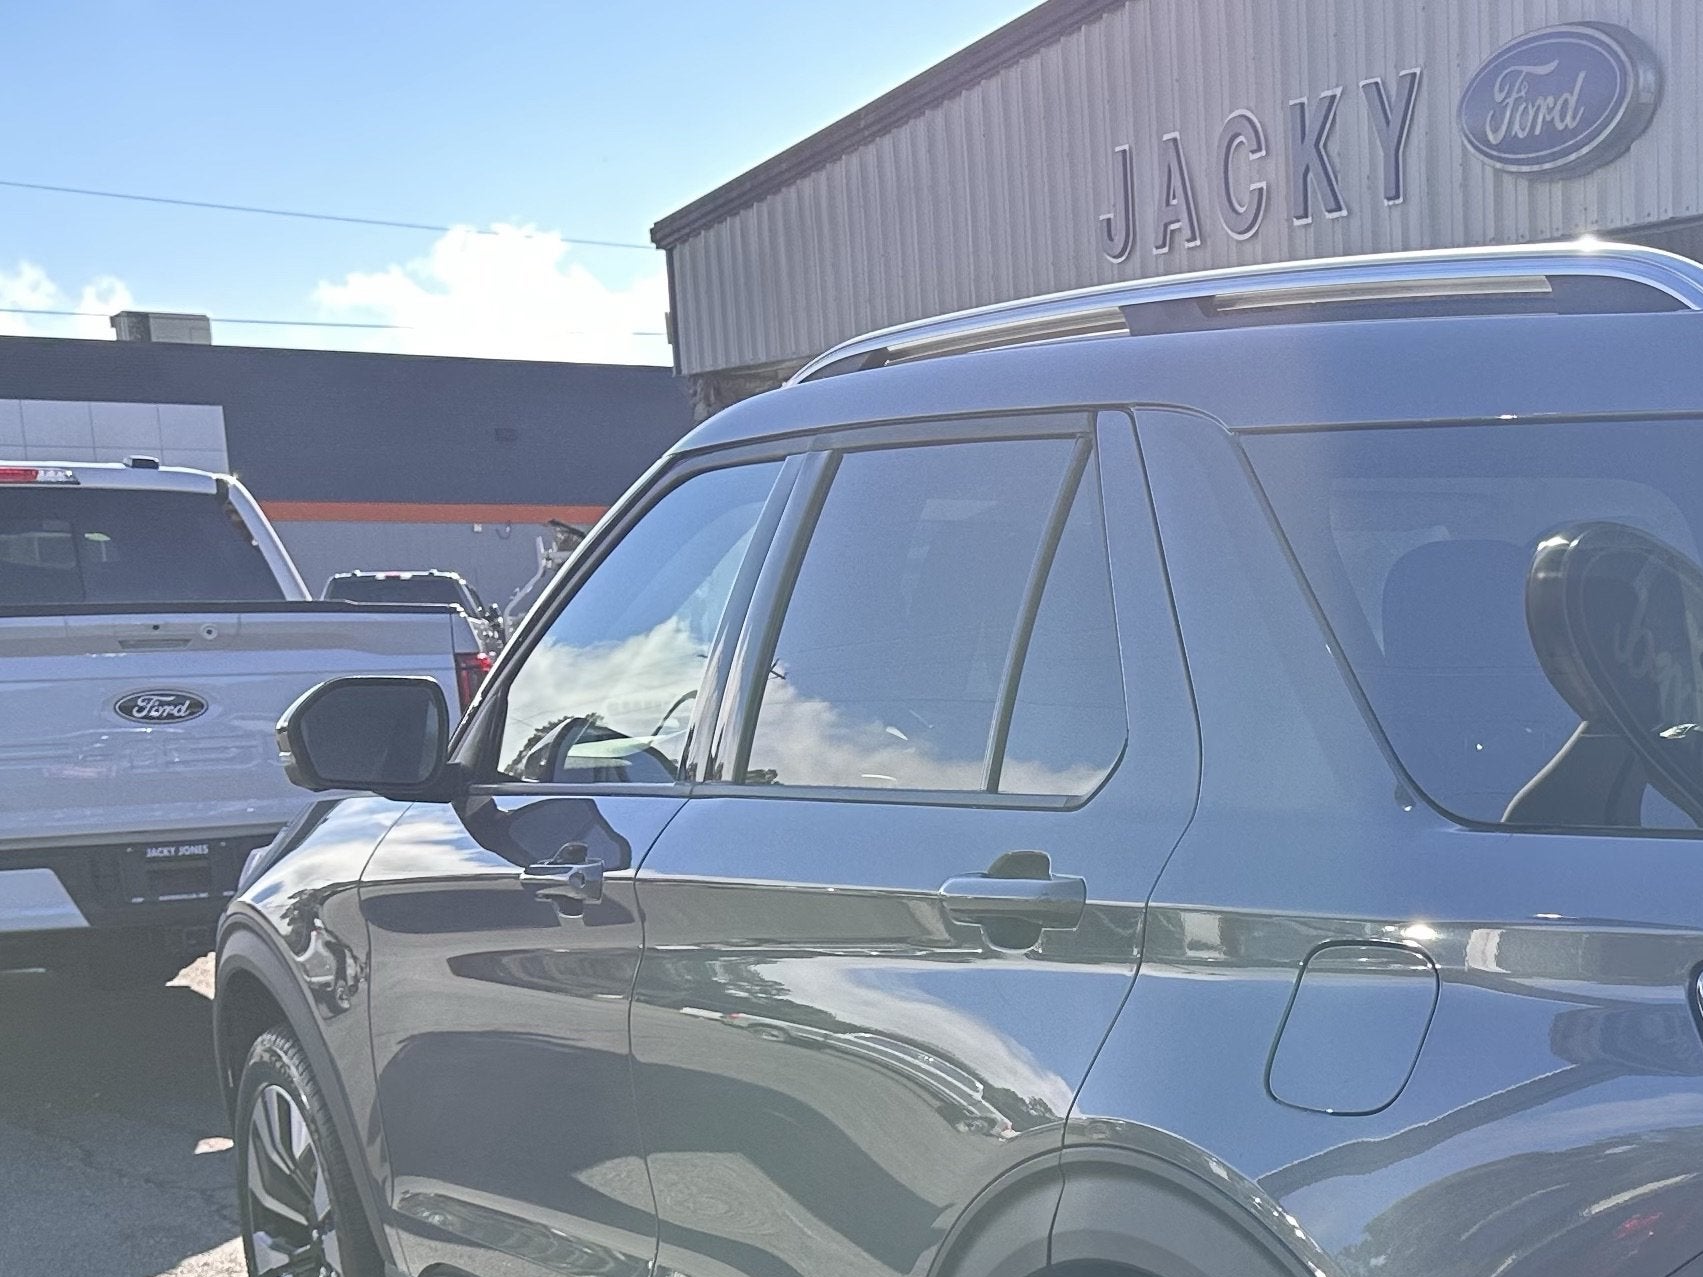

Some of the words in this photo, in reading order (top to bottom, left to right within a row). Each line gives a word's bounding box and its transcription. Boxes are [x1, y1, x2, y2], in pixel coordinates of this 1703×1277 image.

[1486, 57, 1587, 144] Ford
[1100, 67, 1423, 264] JACKY
[132, 695, 192, 718] Ford
[146, 846, 176, 858] JACKY
[178, 844, 209, 857] JONES
